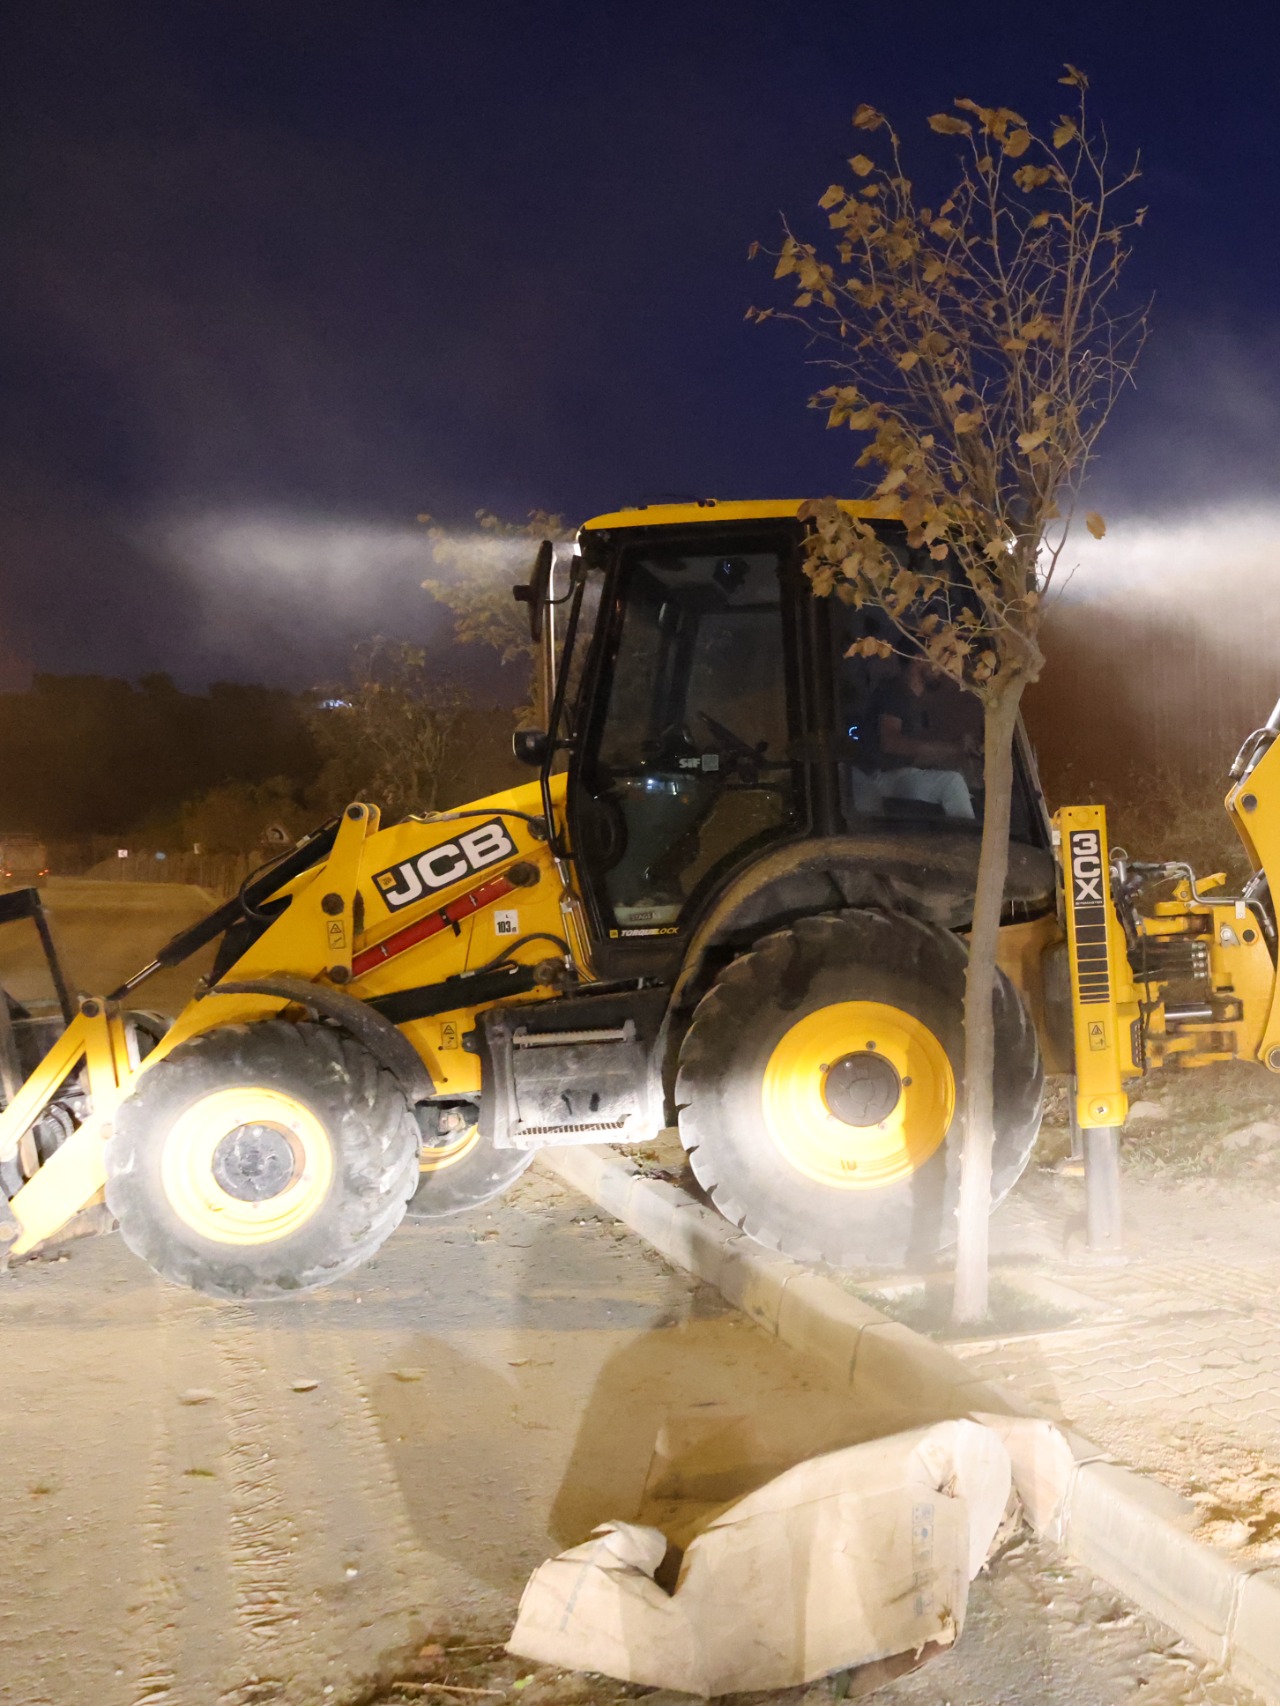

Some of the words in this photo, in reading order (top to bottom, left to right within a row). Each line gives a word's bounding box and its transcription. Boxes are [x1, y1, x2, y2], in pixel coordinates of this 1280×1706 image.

[385, 823, 512, 906] JCB
[1072, 833, 1102, 900] 3CX
[497, 921, 511, 933] 103
